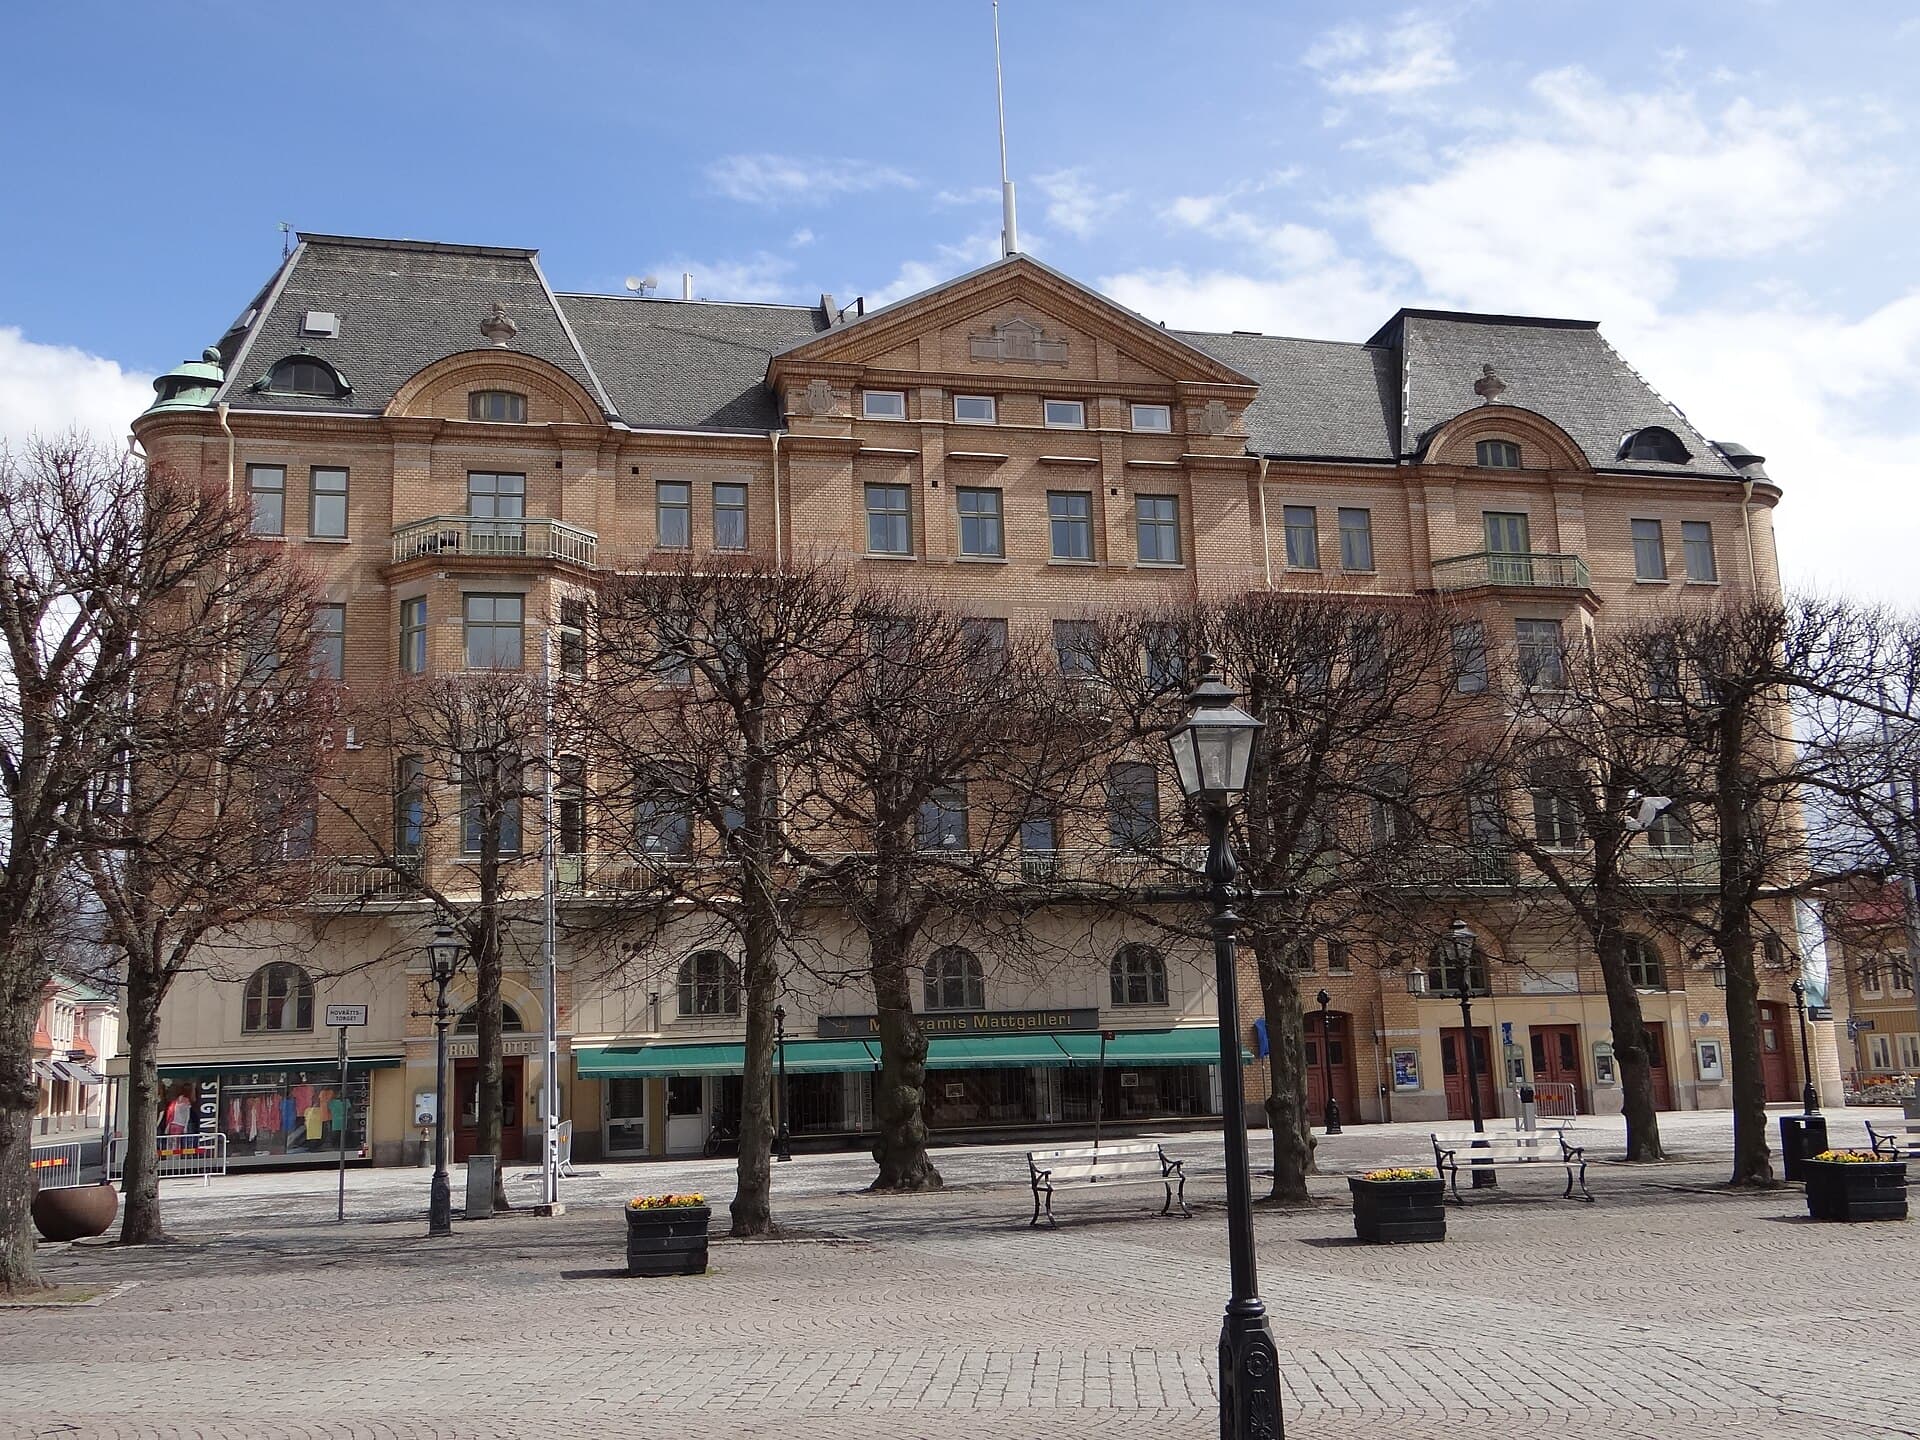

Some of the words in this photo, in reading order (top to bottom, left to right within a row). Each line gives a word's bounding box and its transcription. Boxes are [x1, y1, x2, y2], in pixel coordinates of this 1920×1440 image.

[869, 1016, 967, 1032] Mzamis
[973, 1014, 1071, 1030] Mattgalleri
[501, 1041, 540, 1055] OTEL
